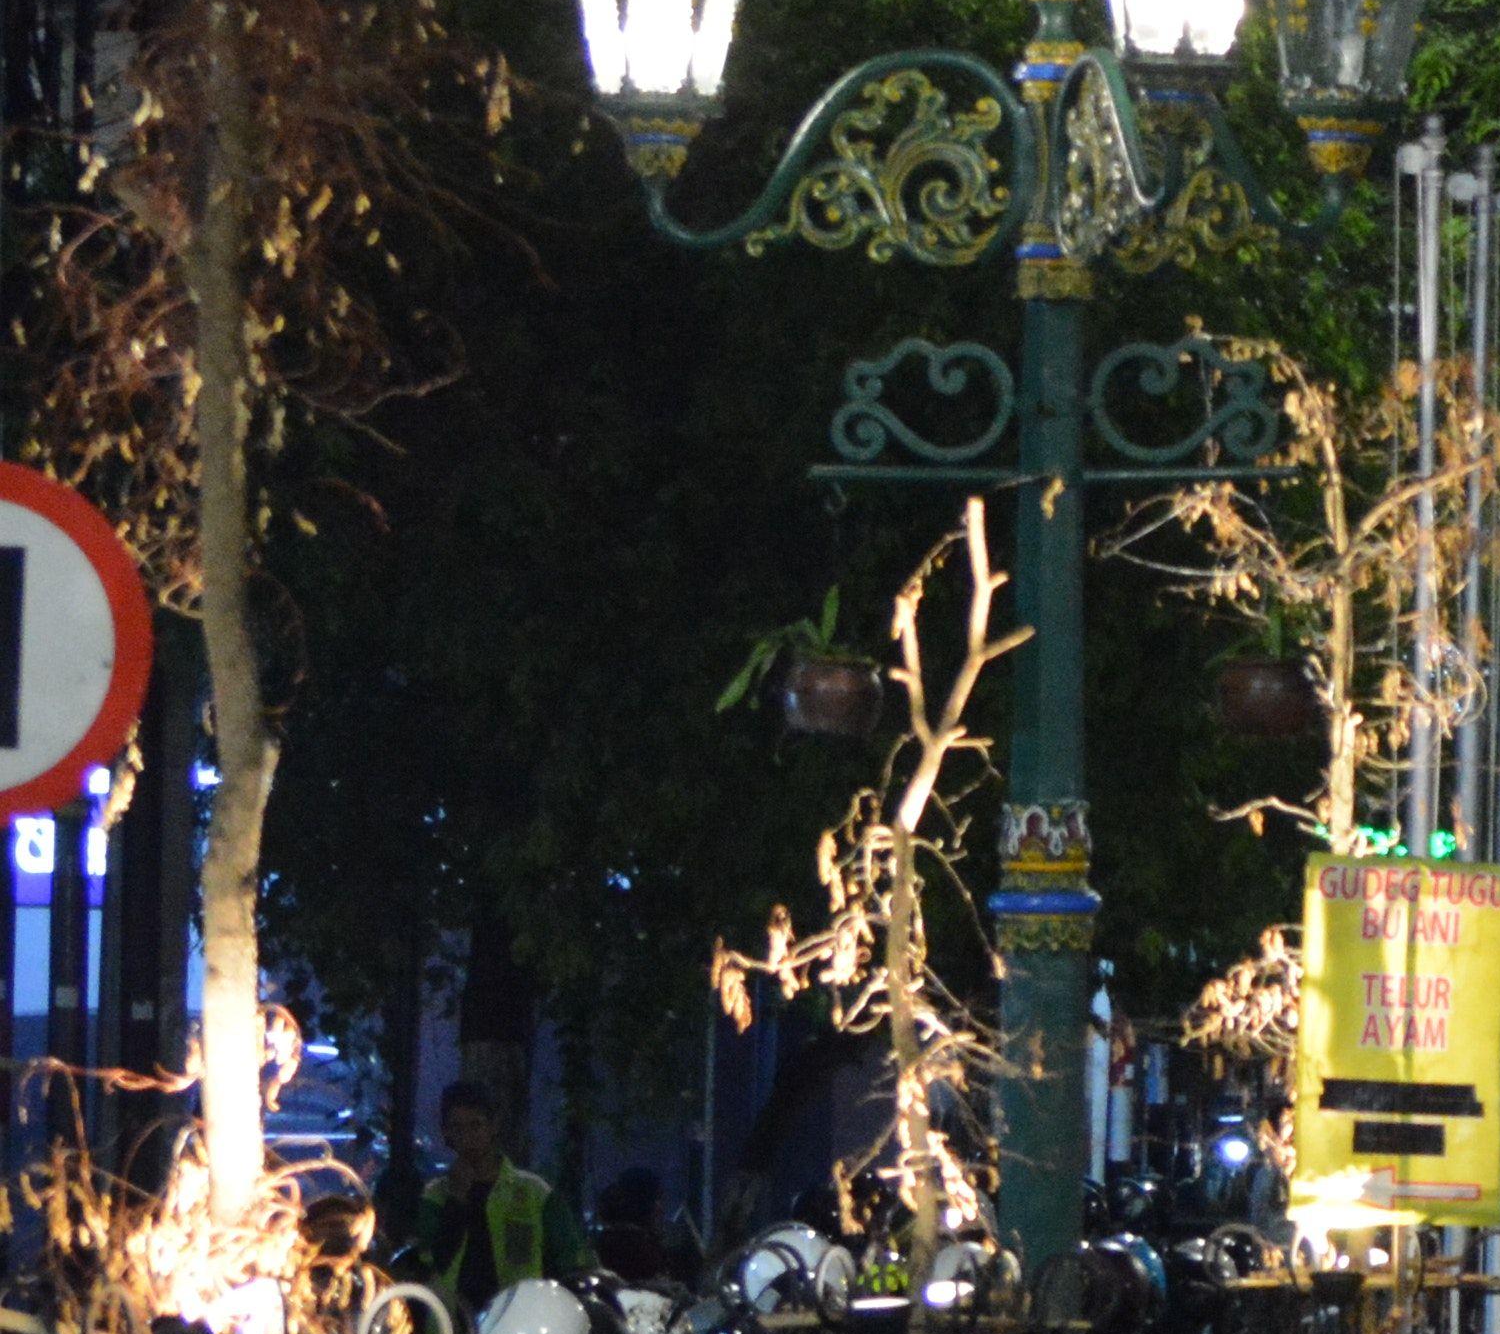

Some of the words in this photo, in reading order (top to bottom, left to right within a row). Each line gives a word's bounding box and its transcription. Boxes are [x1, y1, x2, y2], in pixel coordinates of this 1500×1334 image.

[1318, 866, 1422, 903] GUDEG
[1361, 906, 1401, 941] BU
[1413, 910, 1461, 944] ANI
[1361, 973, 1452, 1010] TELUR
[1361, 1014, 1447, 1048] AYAM
